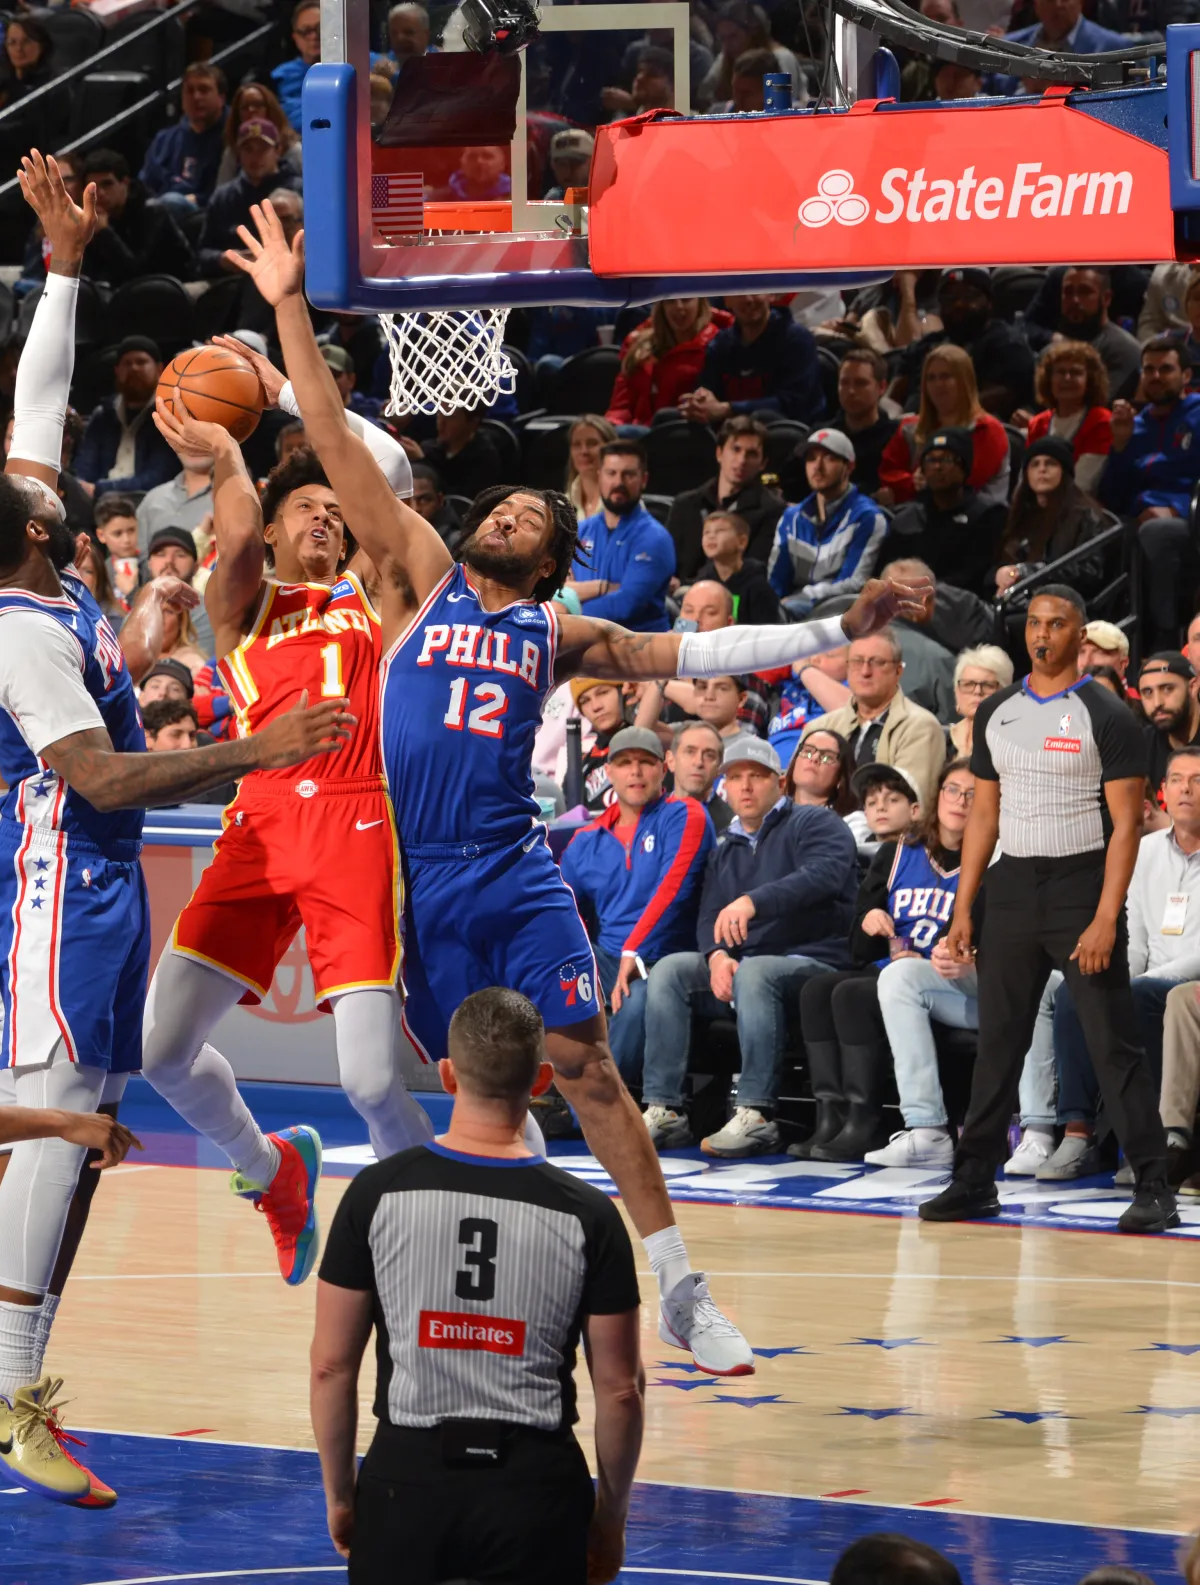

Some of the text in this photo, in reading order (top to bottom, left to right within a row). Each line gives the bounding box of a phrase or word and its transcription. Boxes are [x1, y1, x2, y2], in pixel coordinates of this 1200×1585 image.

[875, 162, 1133, 224] State Farm
[320, 642, 345, 697] 1
[416, 623, 540, 692] PHILA
[443, 677, 510, 740] 12
[1046, 738, 1080, 752] Emirates
[559, 972, 593, 1007] 76
[455, 1217, 498, 1301] 3
[428, 1320, 514, 1347] Emirates
